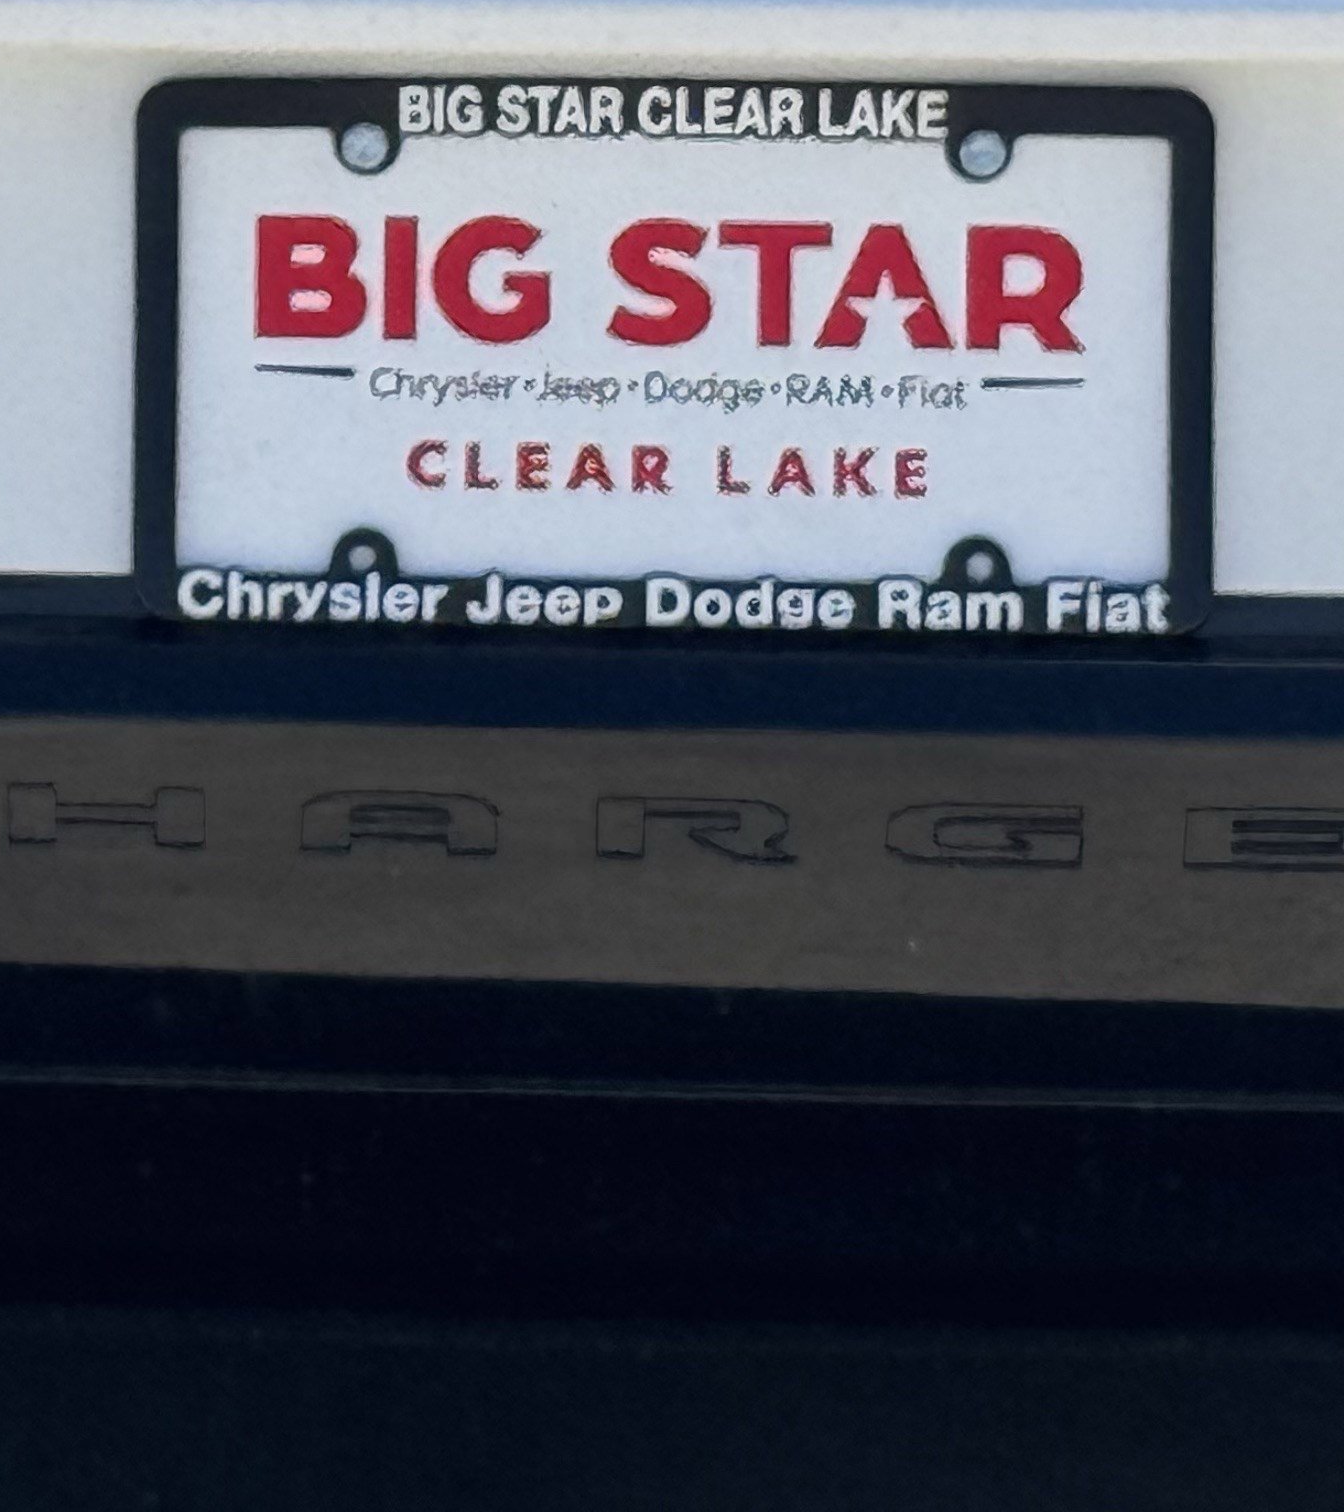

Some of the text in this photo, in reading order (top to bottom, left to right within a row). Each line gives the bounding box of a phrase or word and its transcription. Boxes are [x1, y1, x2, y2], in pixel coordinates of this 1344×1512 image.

[398, 85, 950, 139] BIG STAR CLEAR LAKE
[254, 213, 1086, 354] BIG STAR
[406, 439, 930, 498] CLEAR LAKE
[177, 568, 1169, 634] Chrysler Jeep Dodge Ram Fiat
